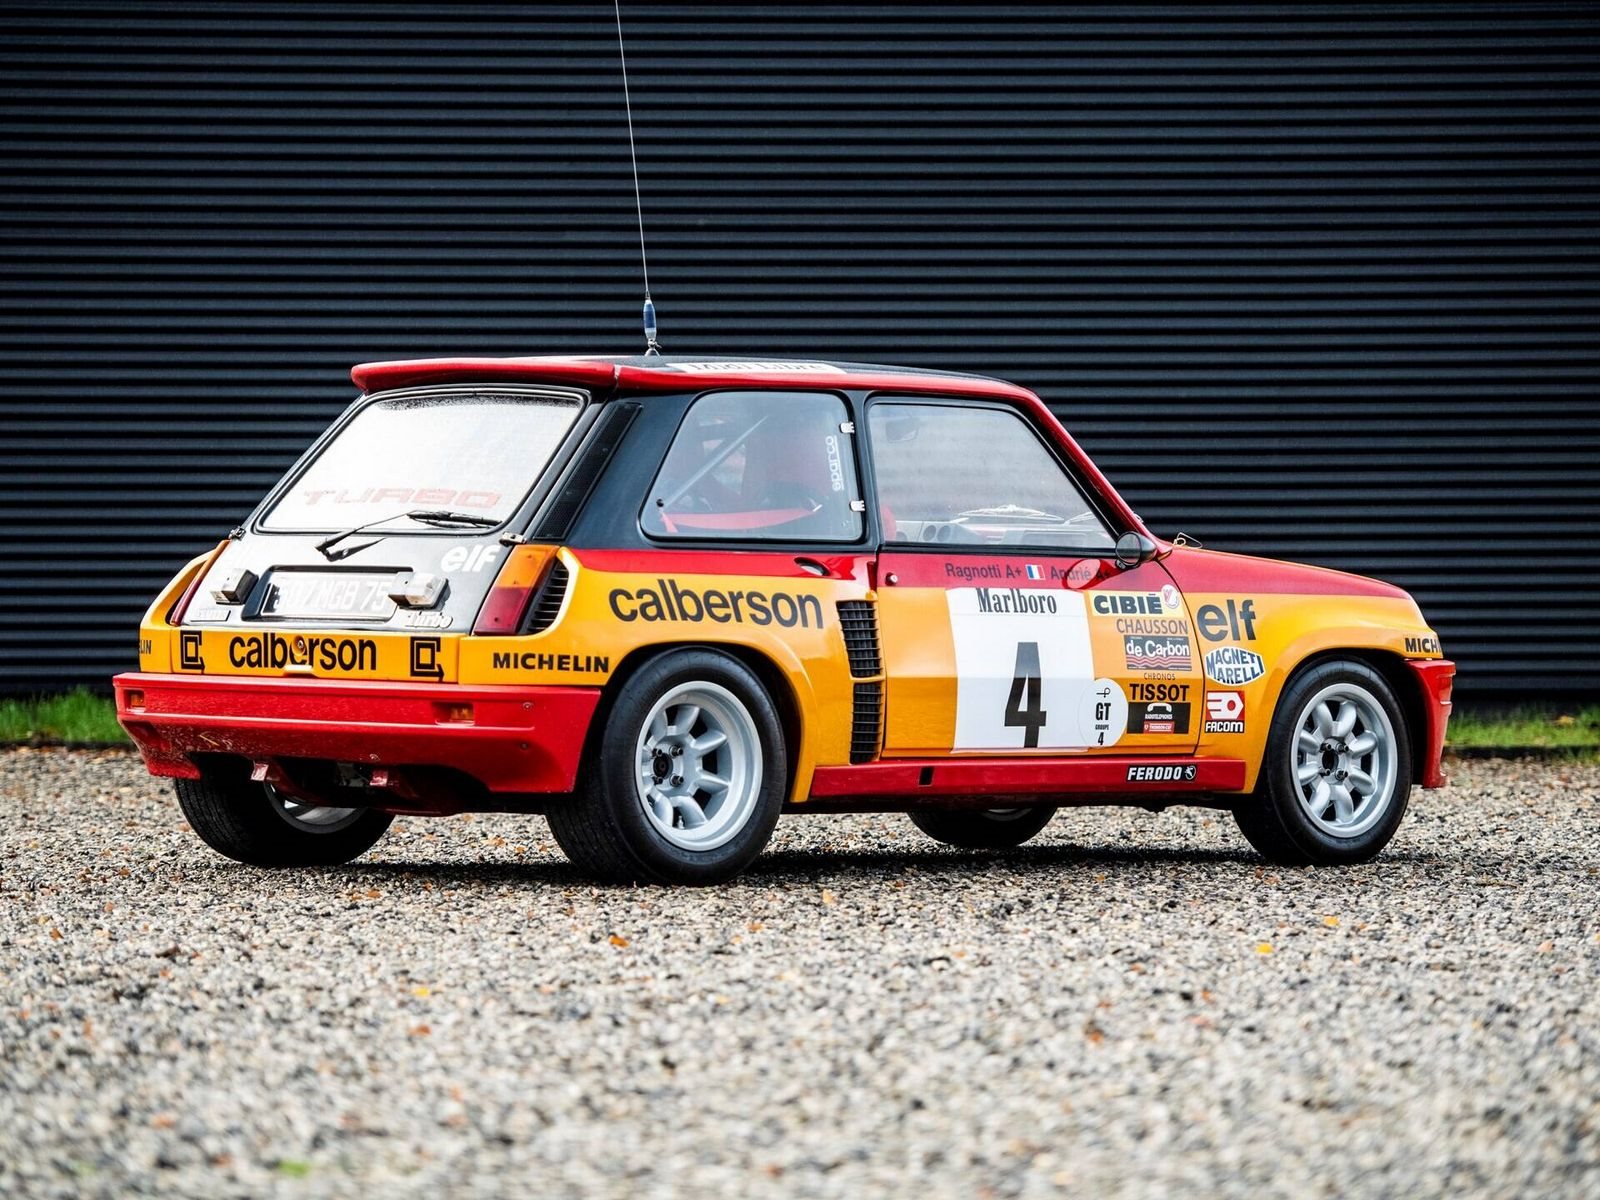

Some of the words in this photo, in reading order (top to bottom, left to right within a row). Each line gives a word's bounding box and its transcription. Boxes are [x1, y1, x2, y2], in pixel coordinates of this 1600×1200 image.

[825, 435, 842, 491] sparco
[304, 488, 501, 508] TURBO
[441, 544, 500, 573] elf
[945, 563, 1001, 580] Ragnotti
[1006, 565, 1022, 578] A+
[608, 578, 824, 629] calberson
[975, 587, 1057, 614] Marlboro
[1117, 618, 1188, 634] CHAUSSON
[1196, 599, 1257, 642] elf
[1126, 640, 1143, 657] de
[1145, 640, 1190, 658] Carbon
[493, 652, 609, 673] MICHELIN
[1206, 648, 1264, 672] MAGNETI
[1144, 672, 1176, 681] CHRONOS
[1206, 664, 1264, 684] MARELLI
[1004, 642, 1047, 748] 4
[1129, 683, 1190, 701] TISSOT
[1095, 702, 1111, 721] GT
[1205, 721, 1244, 733] FACOM
[1097, 732, 1104, 746] 4
[1127, 766, 1183, 781] FERODO
